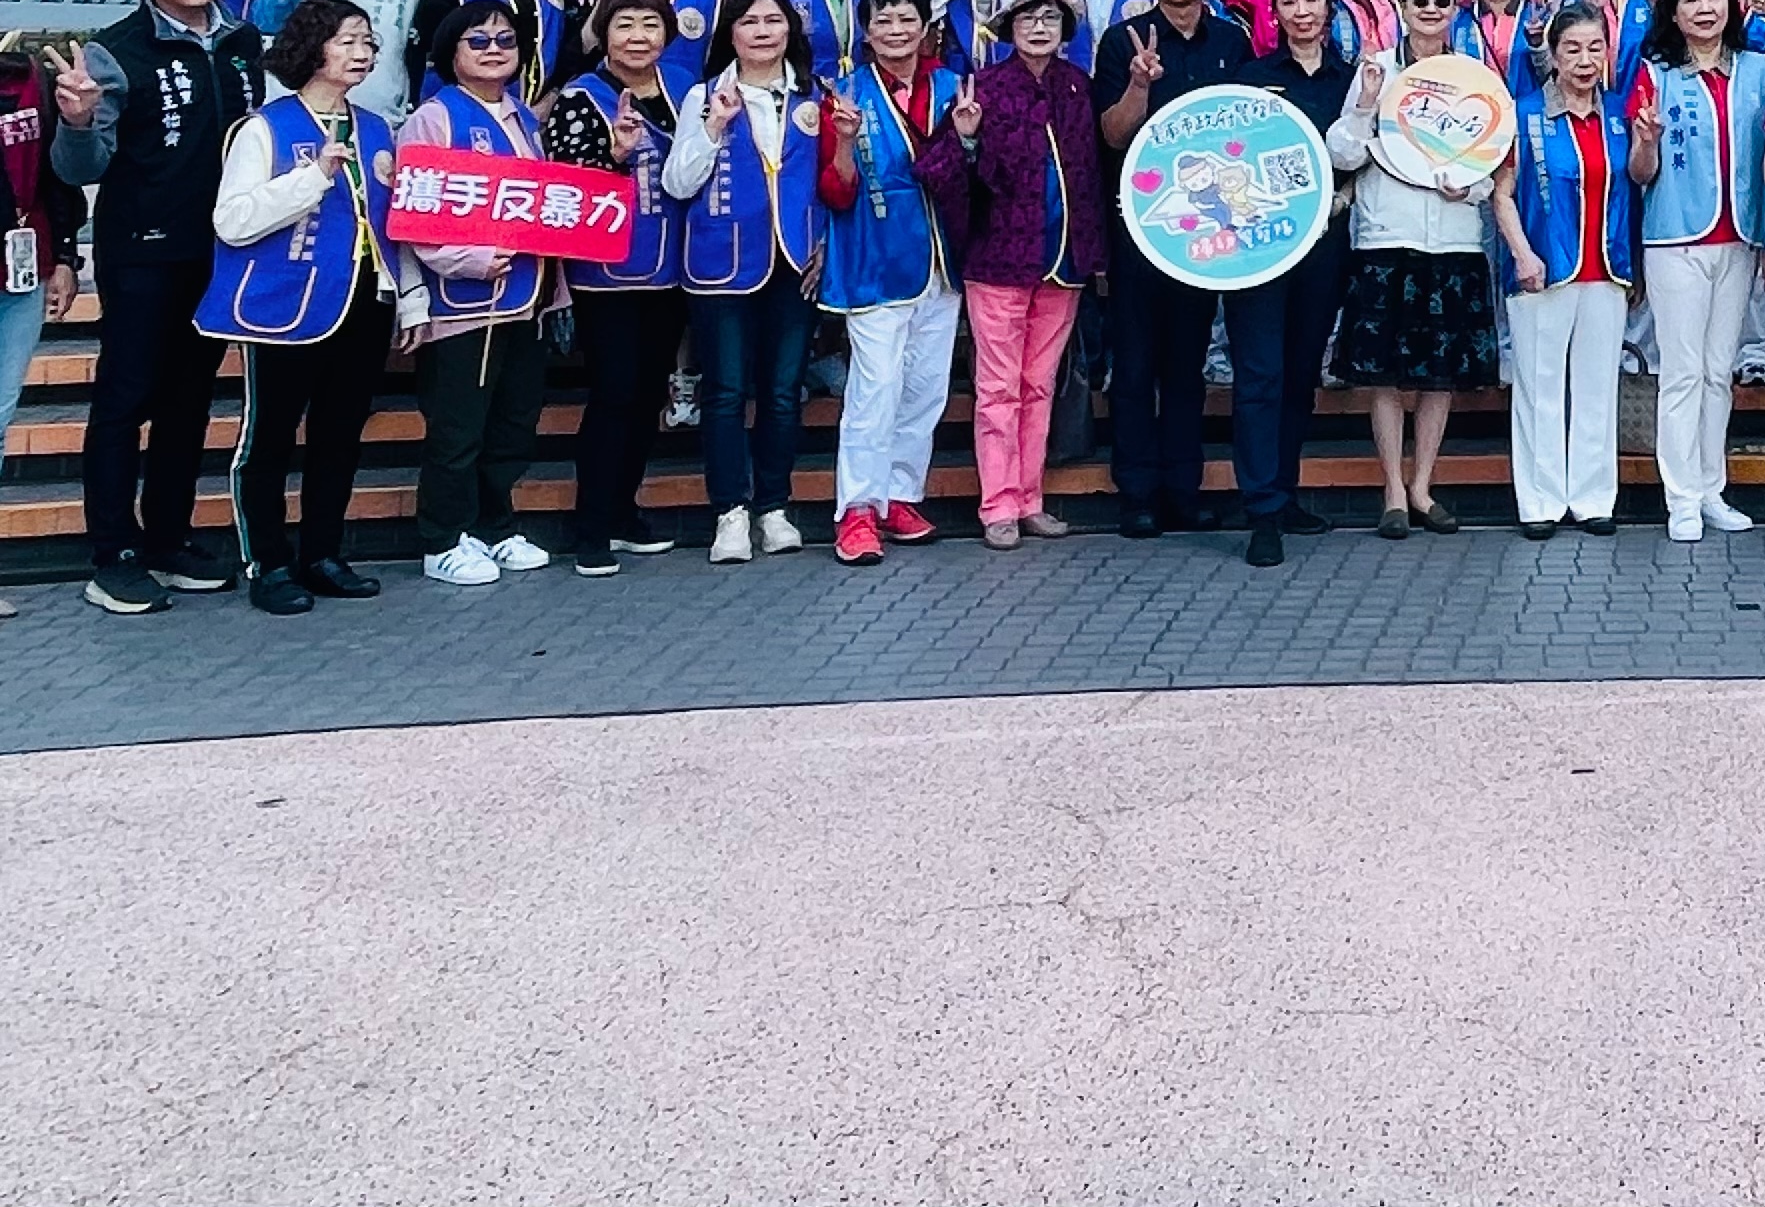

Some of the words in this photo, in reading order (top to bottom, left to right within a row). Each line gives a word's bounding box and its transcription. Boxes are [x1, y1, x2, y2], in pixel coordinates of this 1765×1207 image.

[391, 165, 628, 233] 攜手反暴力
